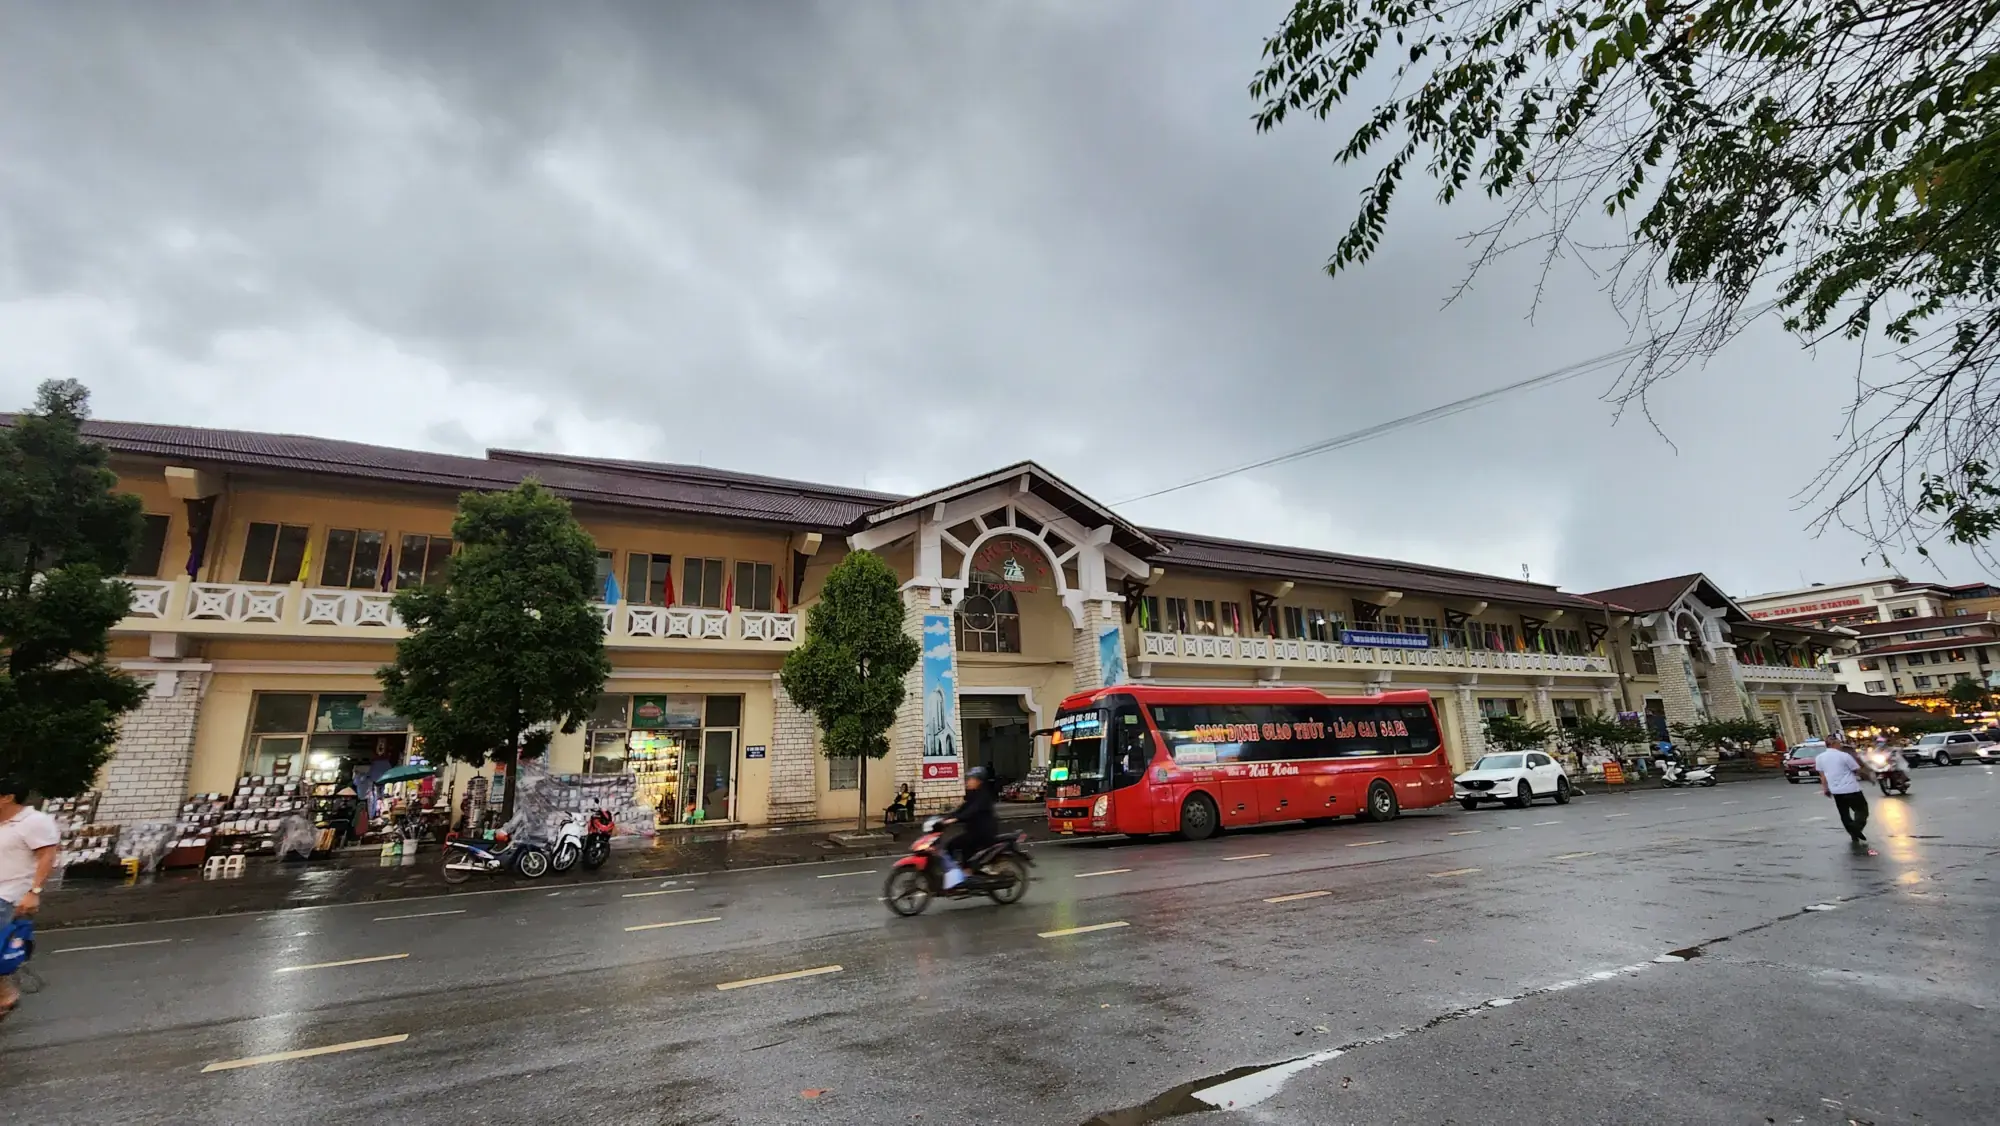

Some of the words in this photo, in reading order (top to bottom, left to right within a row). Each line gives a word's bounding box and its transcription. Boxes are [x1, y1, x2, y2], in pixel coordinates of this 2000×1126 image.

[1774, 606, 1798, 616] SAPA
[1800, 603, 1818, 612] BUS
[1821, 598, 1860, 609] STATION
[1194, 724, 1225, 742] NAM
[1225, 722, 1260, 745] ĐỊNH
[1262, 722, 1292, 741] GIAO
[1333, 716, 1357, 739] LÀO
[1358, 721, 1378, 738] CAI
